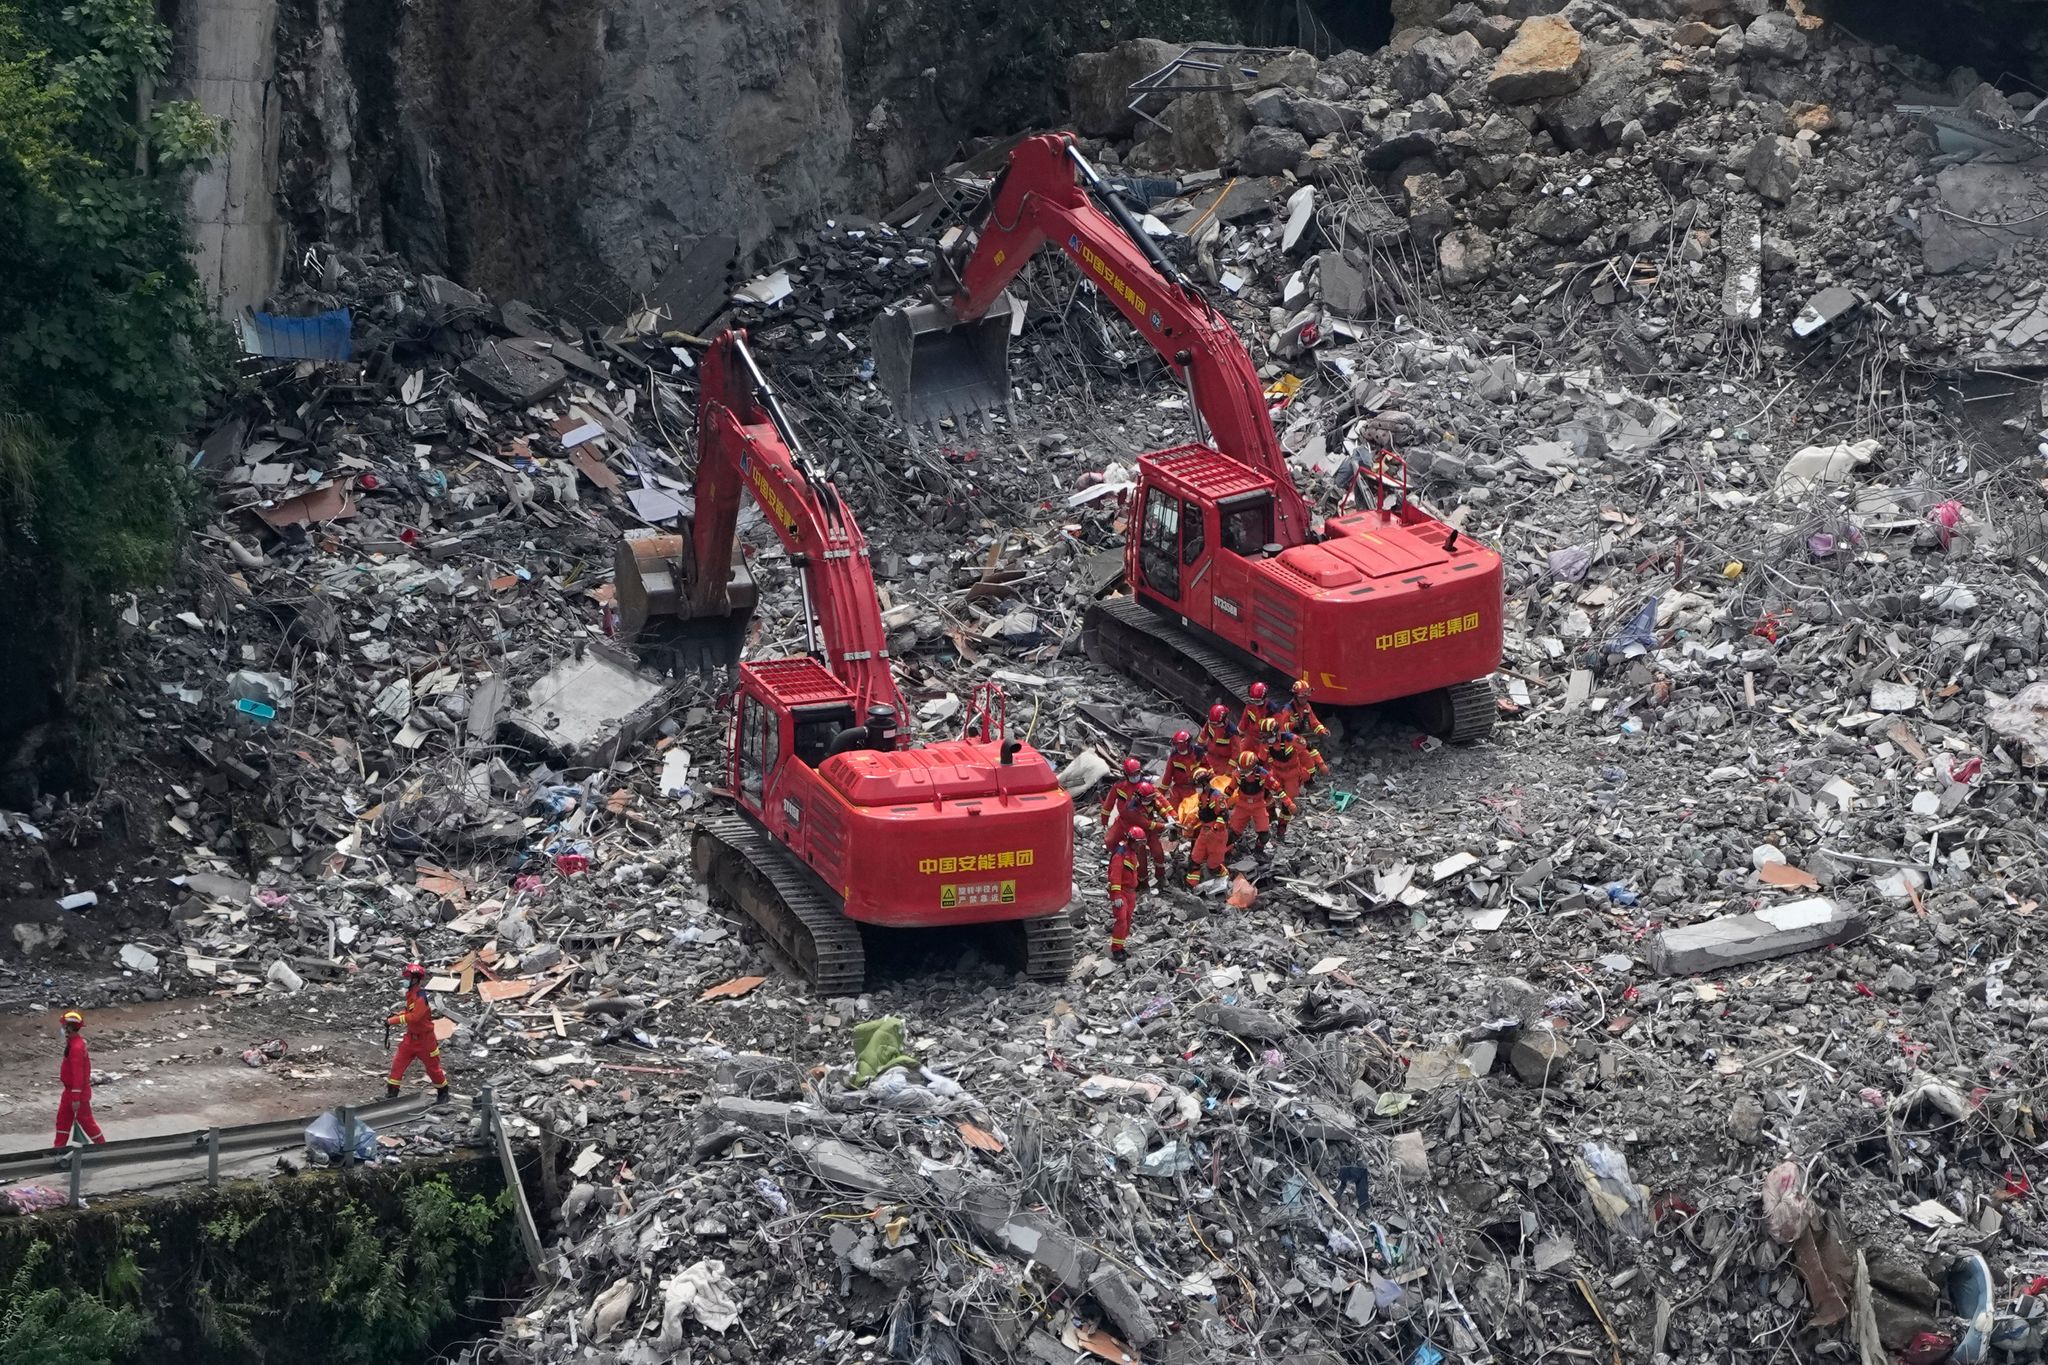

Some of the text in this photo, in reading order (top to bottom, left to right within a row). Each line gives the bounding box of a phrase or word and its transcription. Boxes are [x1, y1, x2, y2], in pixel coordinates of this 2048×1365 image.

[1082, 246, 1146, 316] 中国安能集团
[1375, 612, 1479, 651] 中国安能集团
[919, 849, 1034, 875] 中国安能集团
